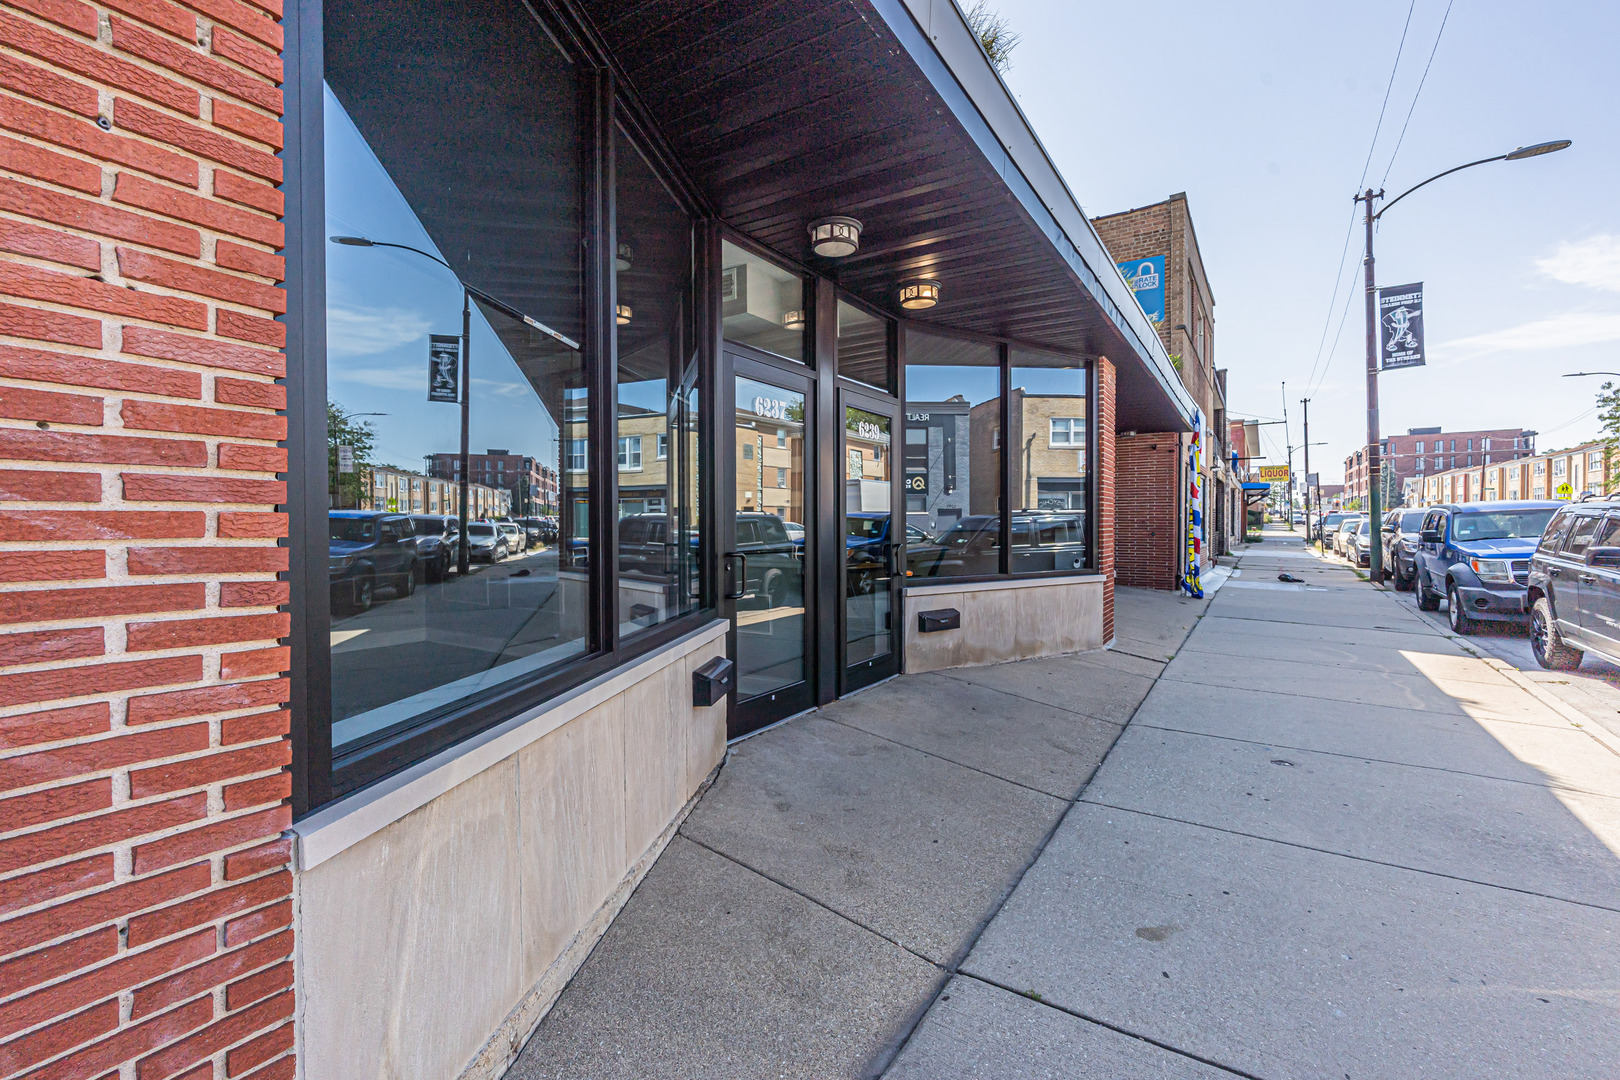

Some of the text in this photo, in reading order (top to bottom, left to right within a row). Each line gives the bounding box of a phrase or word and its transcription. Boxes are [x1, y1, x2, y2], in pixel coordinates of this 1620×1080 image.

[1138, 275, 1158, 283] RATE
[1138, 281, 1157, 289] LOCK
[755, 396, 787, 419] 6237
[858, 421, 880, 440] 6239
[1260, 469, 1289, 478] LIQUOR
